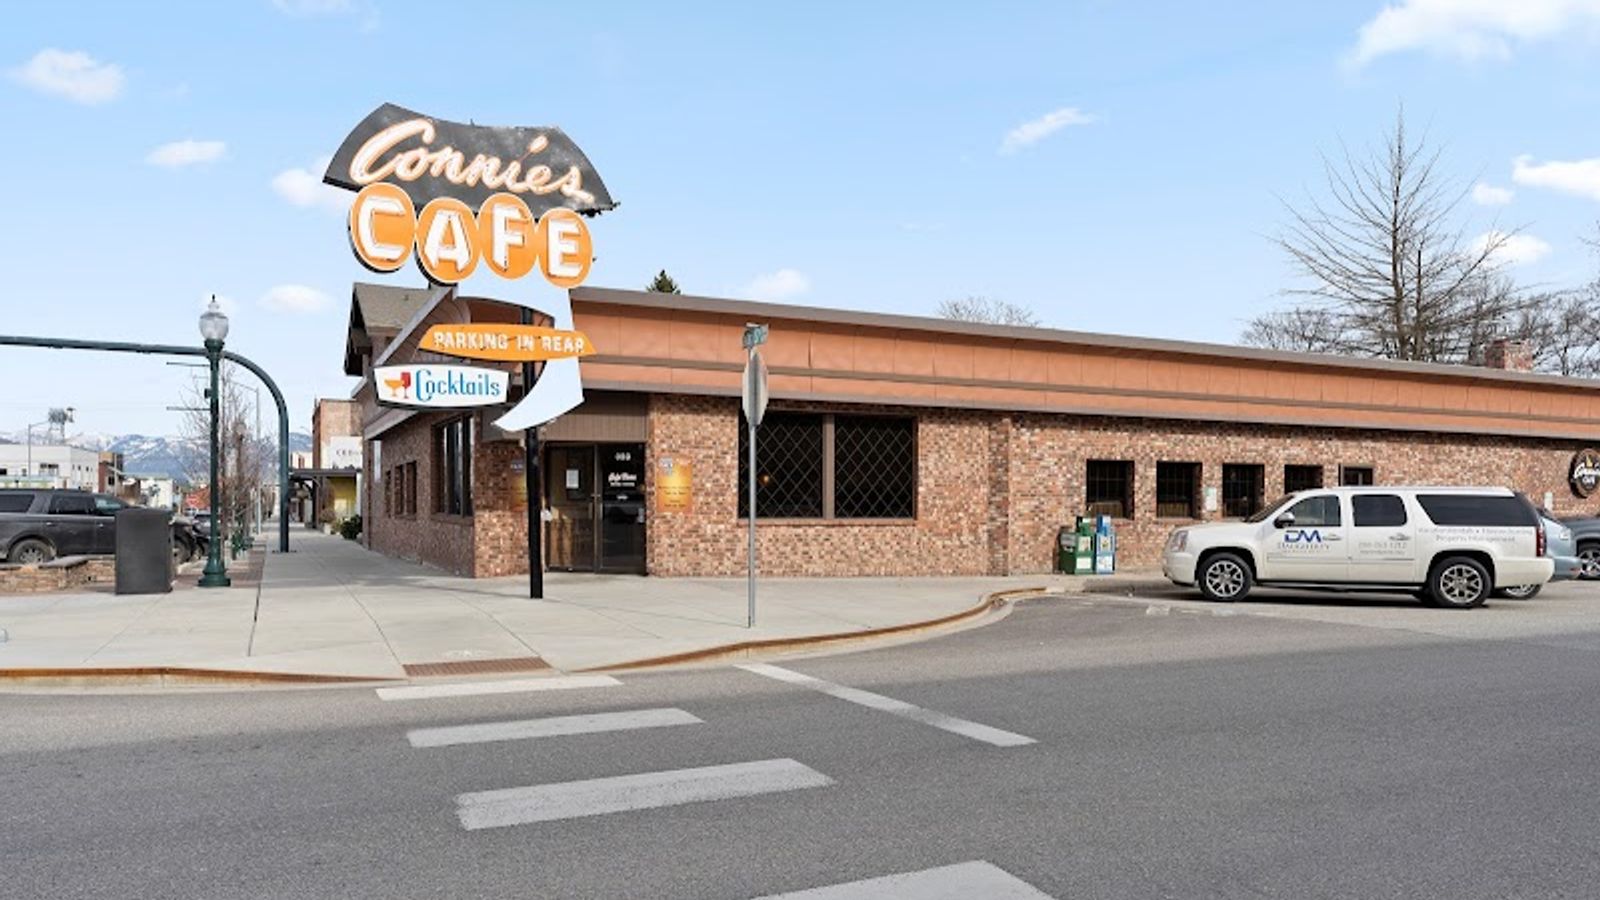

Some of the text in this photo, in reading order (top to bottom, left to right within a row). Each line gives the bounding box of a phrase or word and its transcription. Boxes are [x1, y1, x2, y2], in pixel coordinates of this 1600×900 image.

[357, 195, 582, 278] CAFE
[433, 331, 585, 354] PARKING IN REAR
[415, 368, 501, 402] Cocktails
